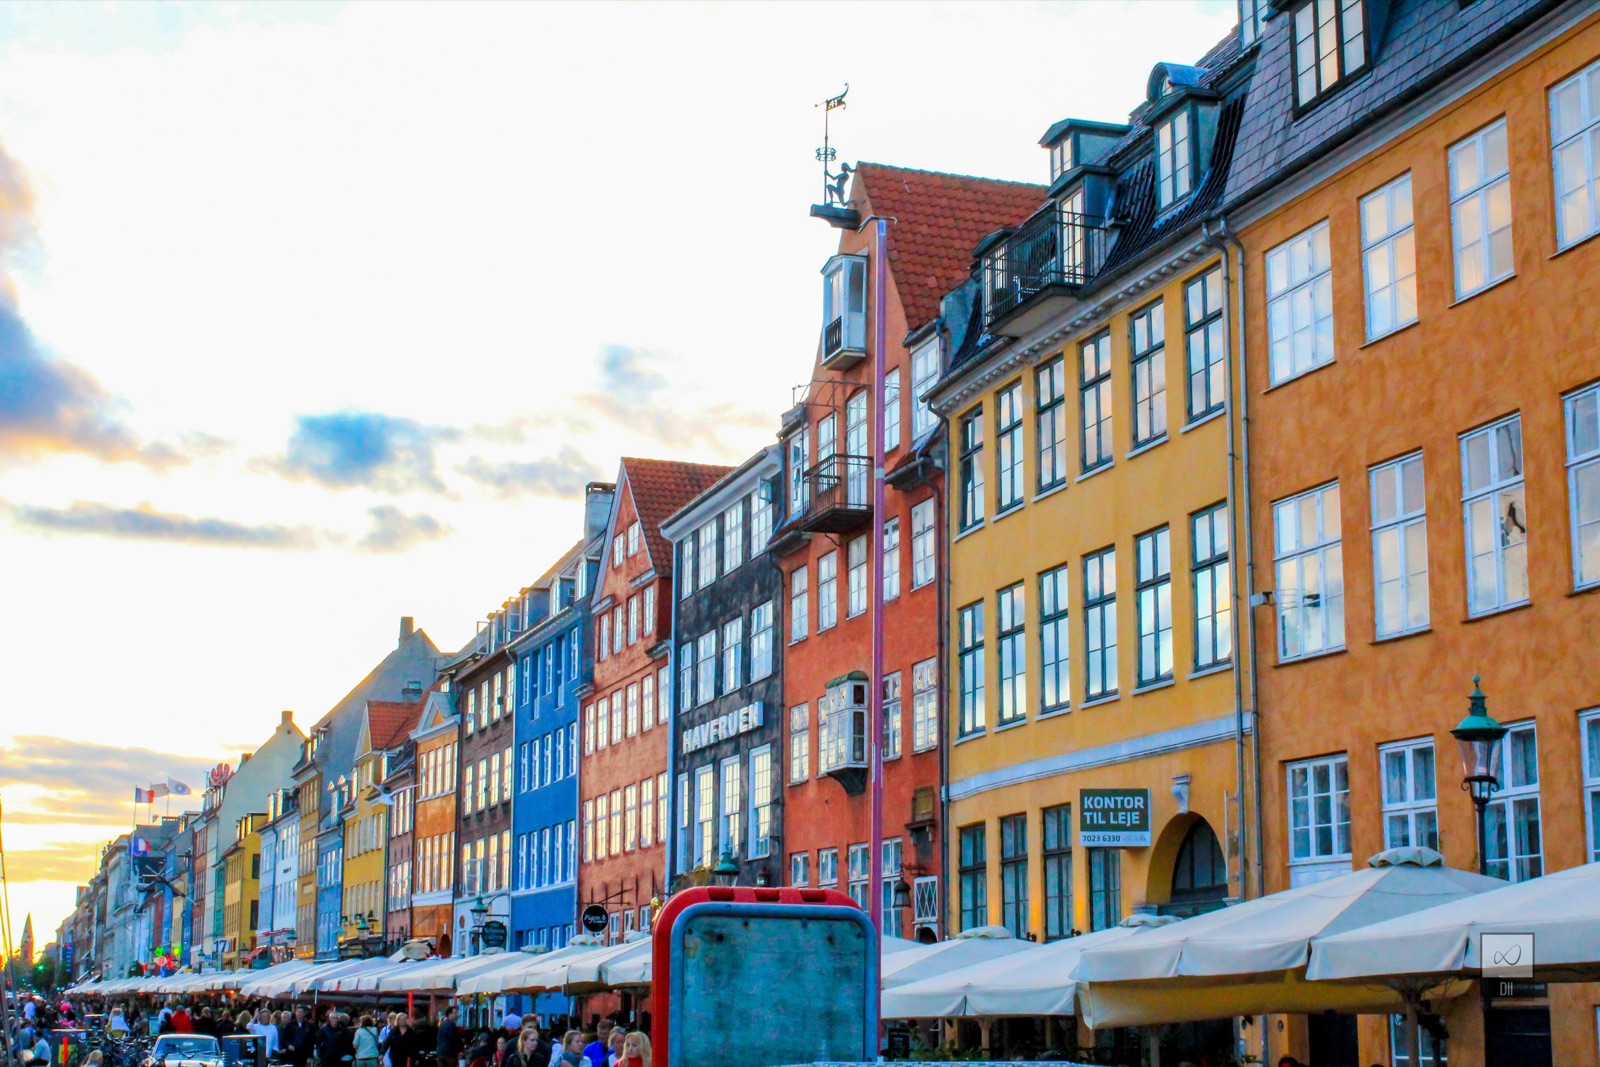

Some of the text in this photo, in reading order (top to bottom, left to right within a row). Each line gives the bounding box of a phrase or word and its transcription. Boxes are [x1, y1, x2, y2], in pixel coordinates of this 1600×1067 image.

[682, 701, 764, 754] HAVFRUEN
[1083, 796, 1144, 809] KONTOR
[1083, 811, 1140, 827] TIL LEJE
